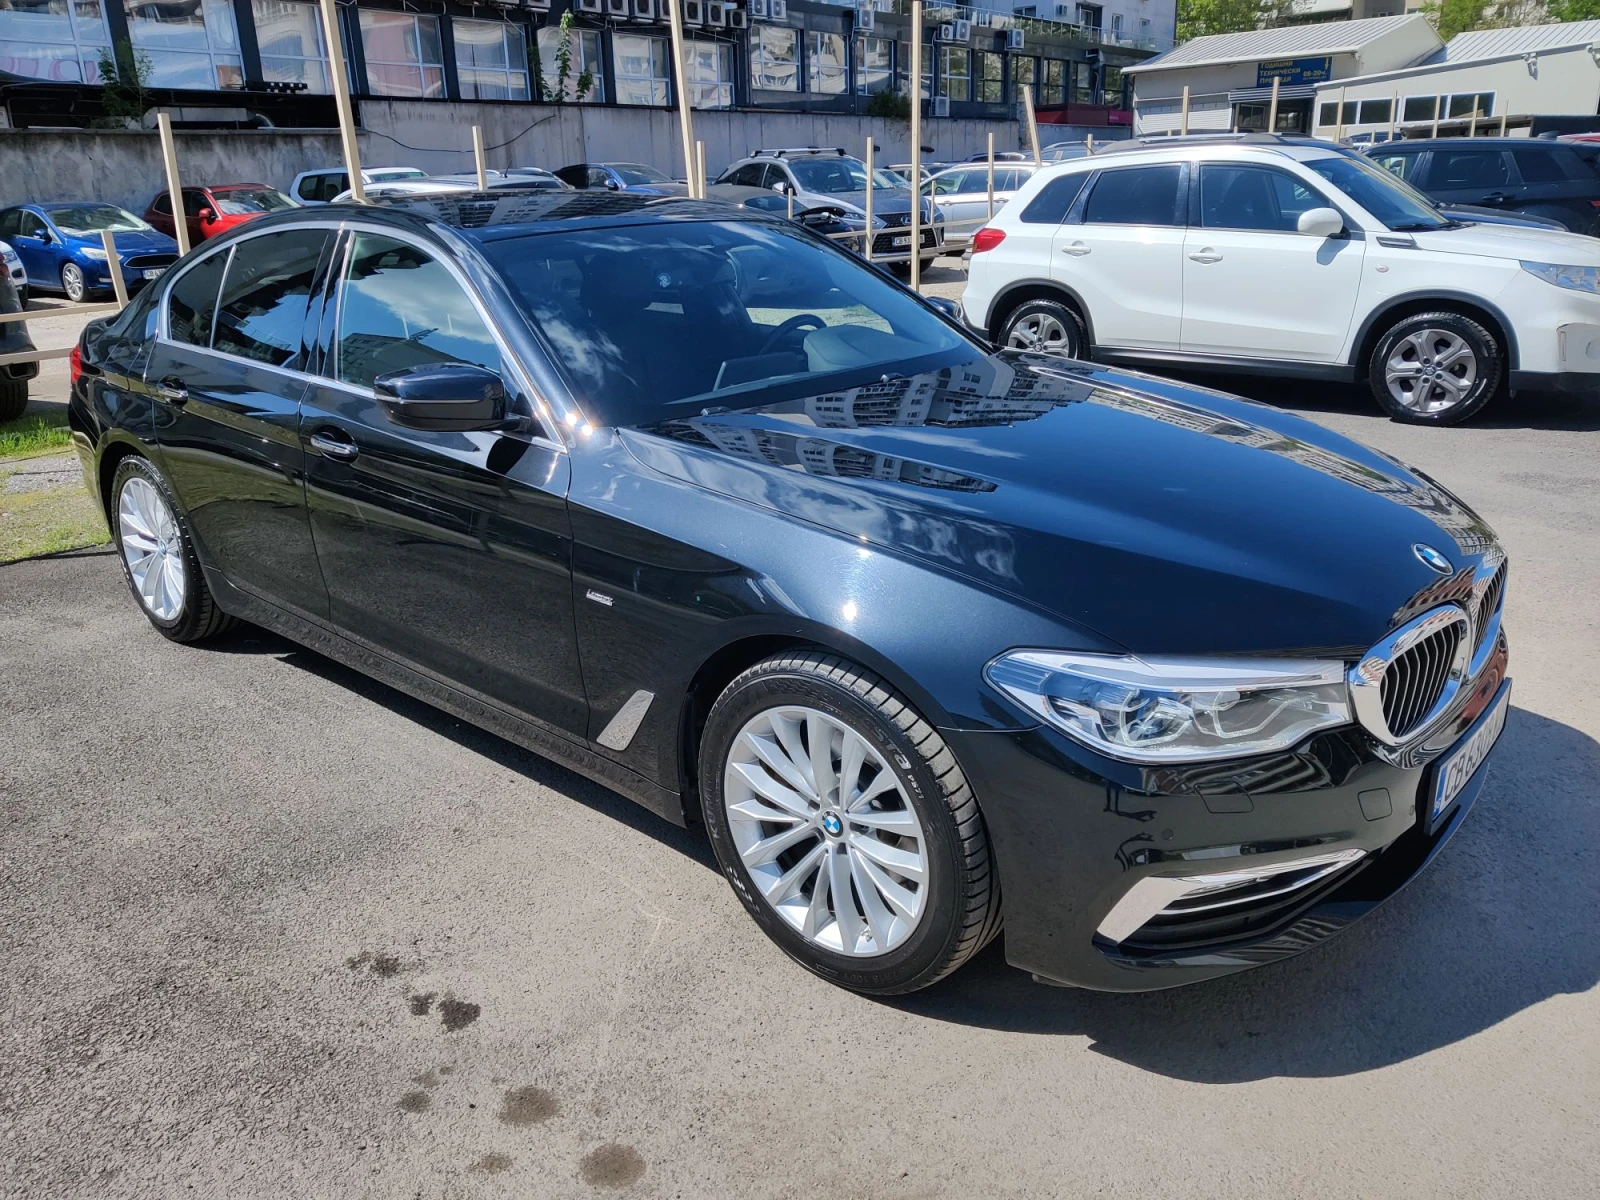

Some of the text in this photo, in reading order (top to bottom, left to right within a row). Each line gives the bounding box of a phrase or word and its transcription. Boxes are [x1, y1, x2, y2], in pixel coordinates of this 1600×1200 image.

[1260, 68, 1300, 76] ТЕХНИЧЕСКИ
[907, 774, 925, 799] PS71
[1444, 755, 1466, 801] CB
